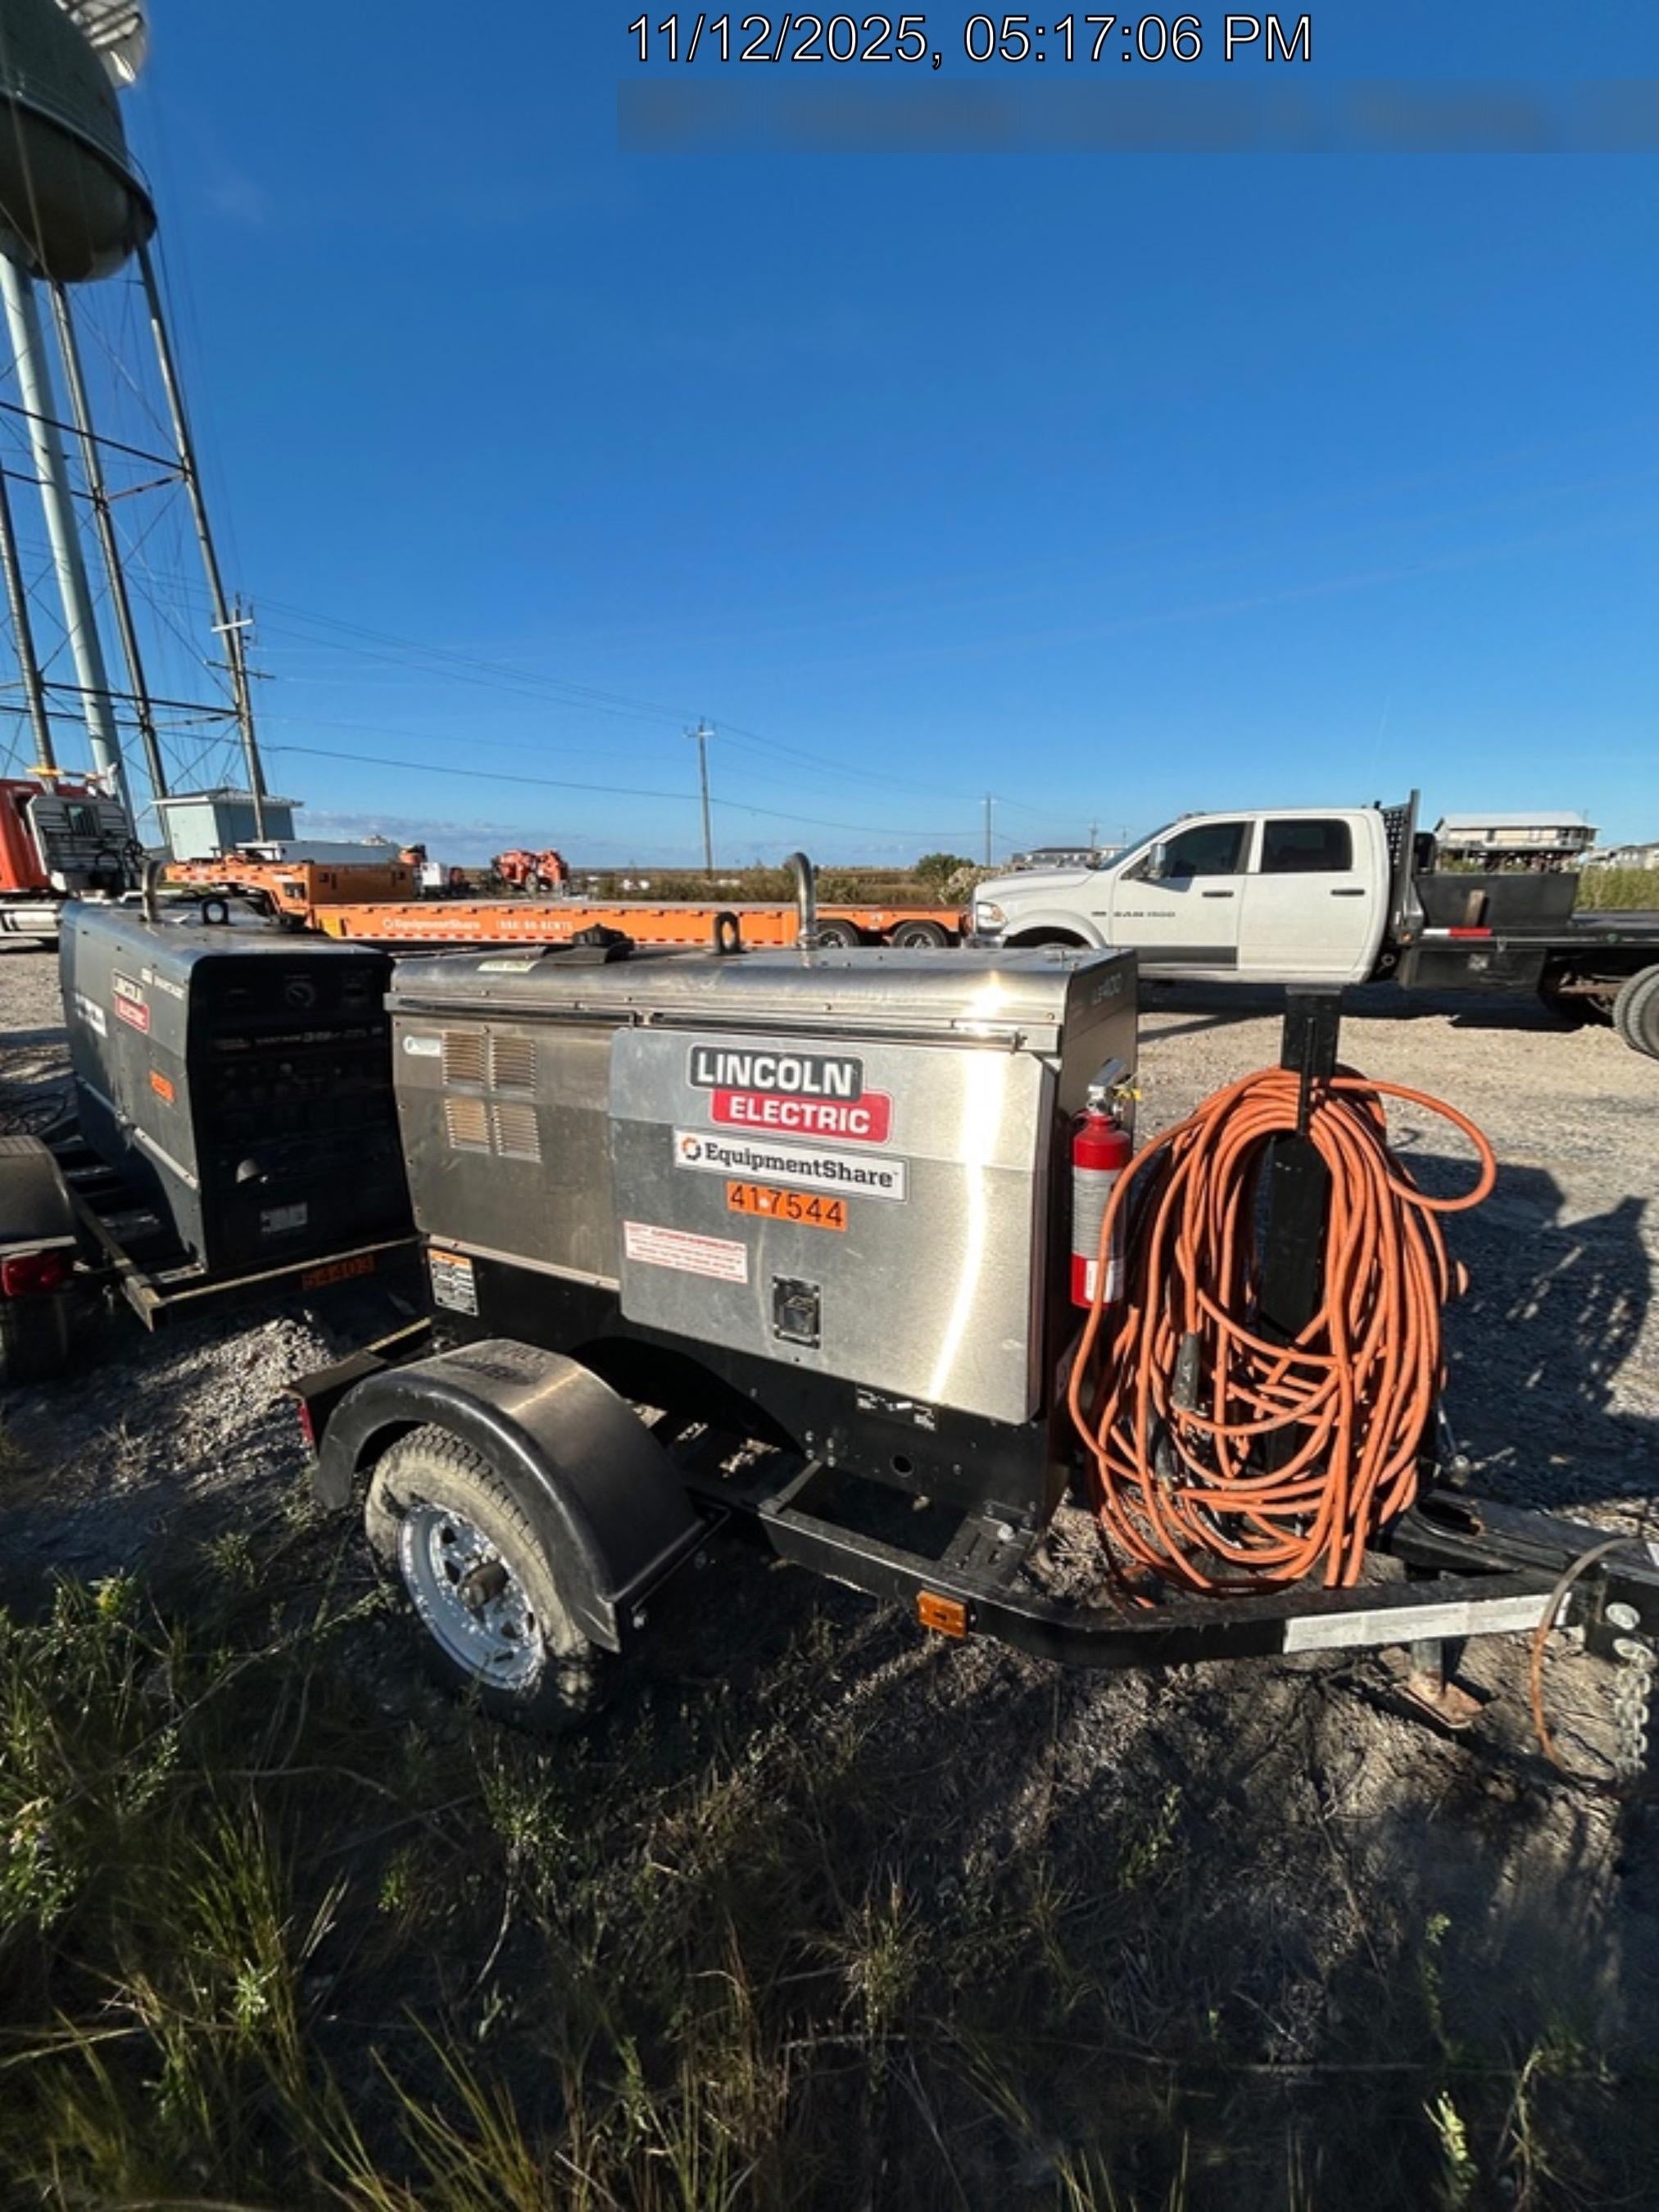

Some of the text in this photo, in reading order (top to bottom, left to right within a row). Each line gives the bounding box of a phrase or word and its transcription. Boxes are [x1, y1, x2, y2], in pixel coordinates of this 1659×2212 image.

[696, 1051, 854, 1097] LINCOLN
[729, 1095, 871, 1134] ELECTRIC
[705, 1142, 894, 1188] EquipmentShare
[729, 1185, 844, 1226] 417544
